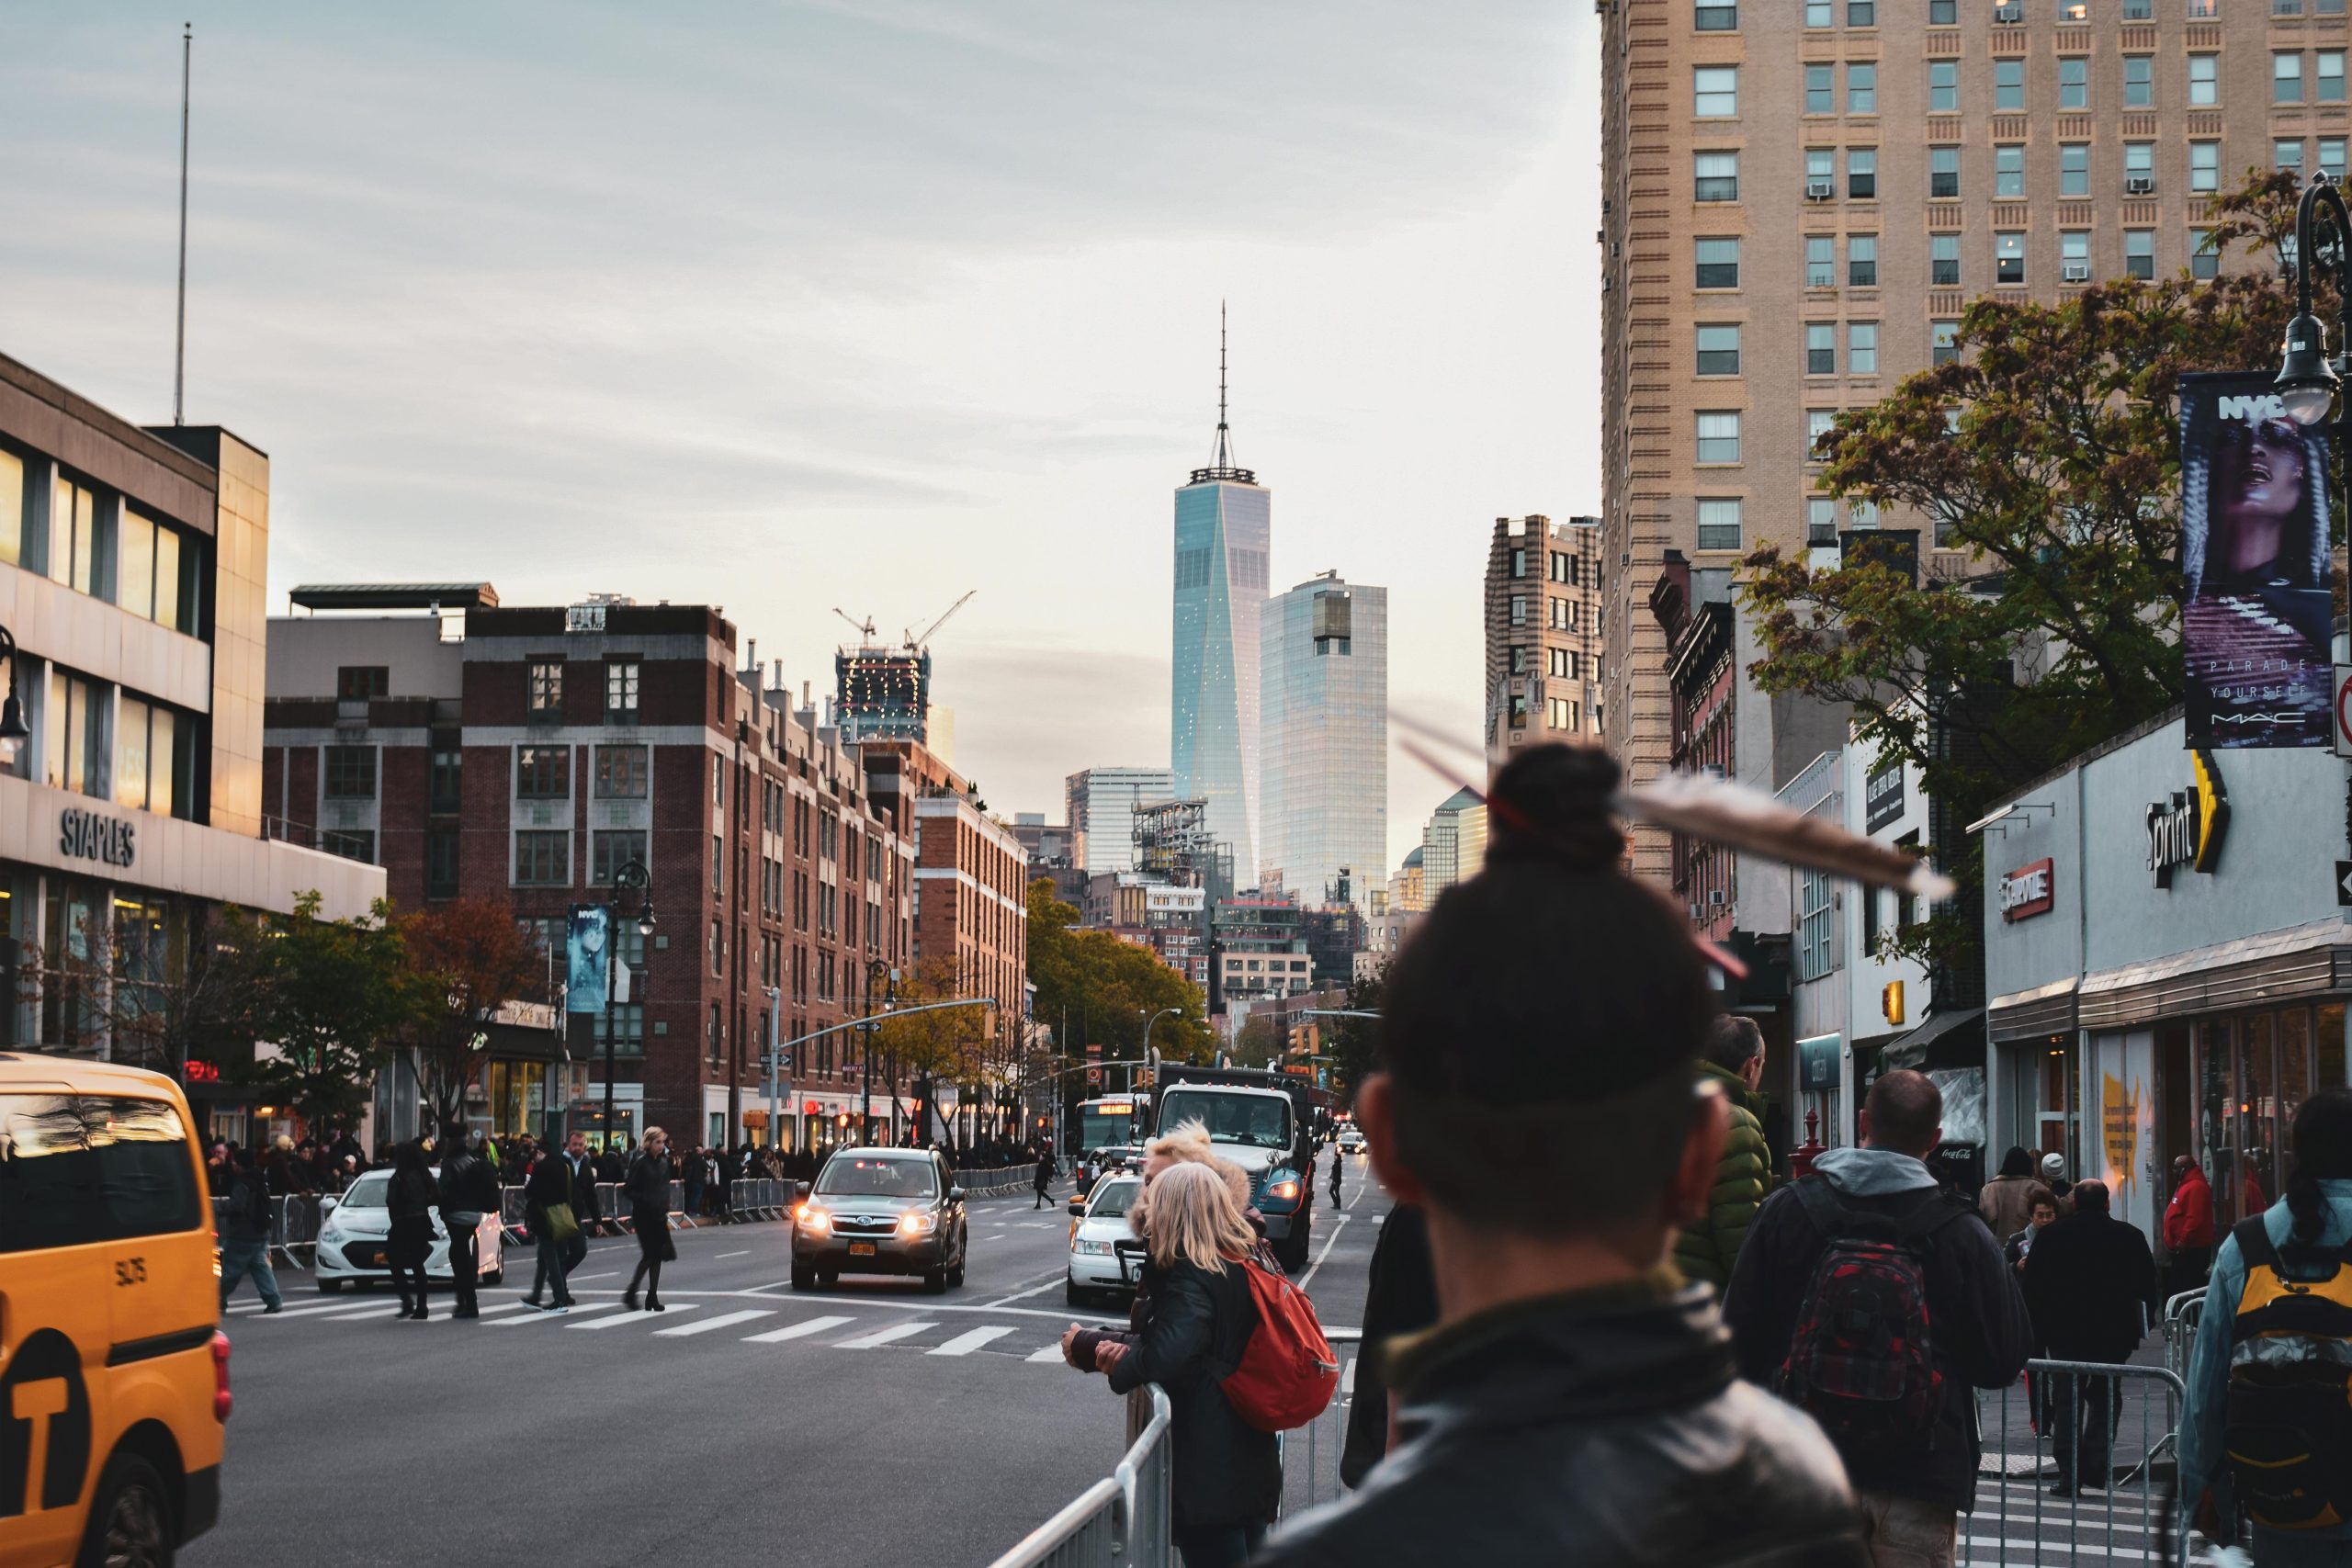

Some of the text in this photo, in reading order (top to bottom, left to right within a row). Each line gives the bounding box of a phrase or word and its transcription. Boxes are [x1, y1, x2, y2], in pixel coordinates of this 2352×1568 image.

[2219, 395, 2288, 420] NYC
[2211, 659, 2306, 672] PARADE
[2211, 684, 2306, 698] YOURSELF
[60, 808, 135, 868] STAPLES
[2145, 787, 2193, 889] Sprint
[578, 909, 599, 919] NYC
